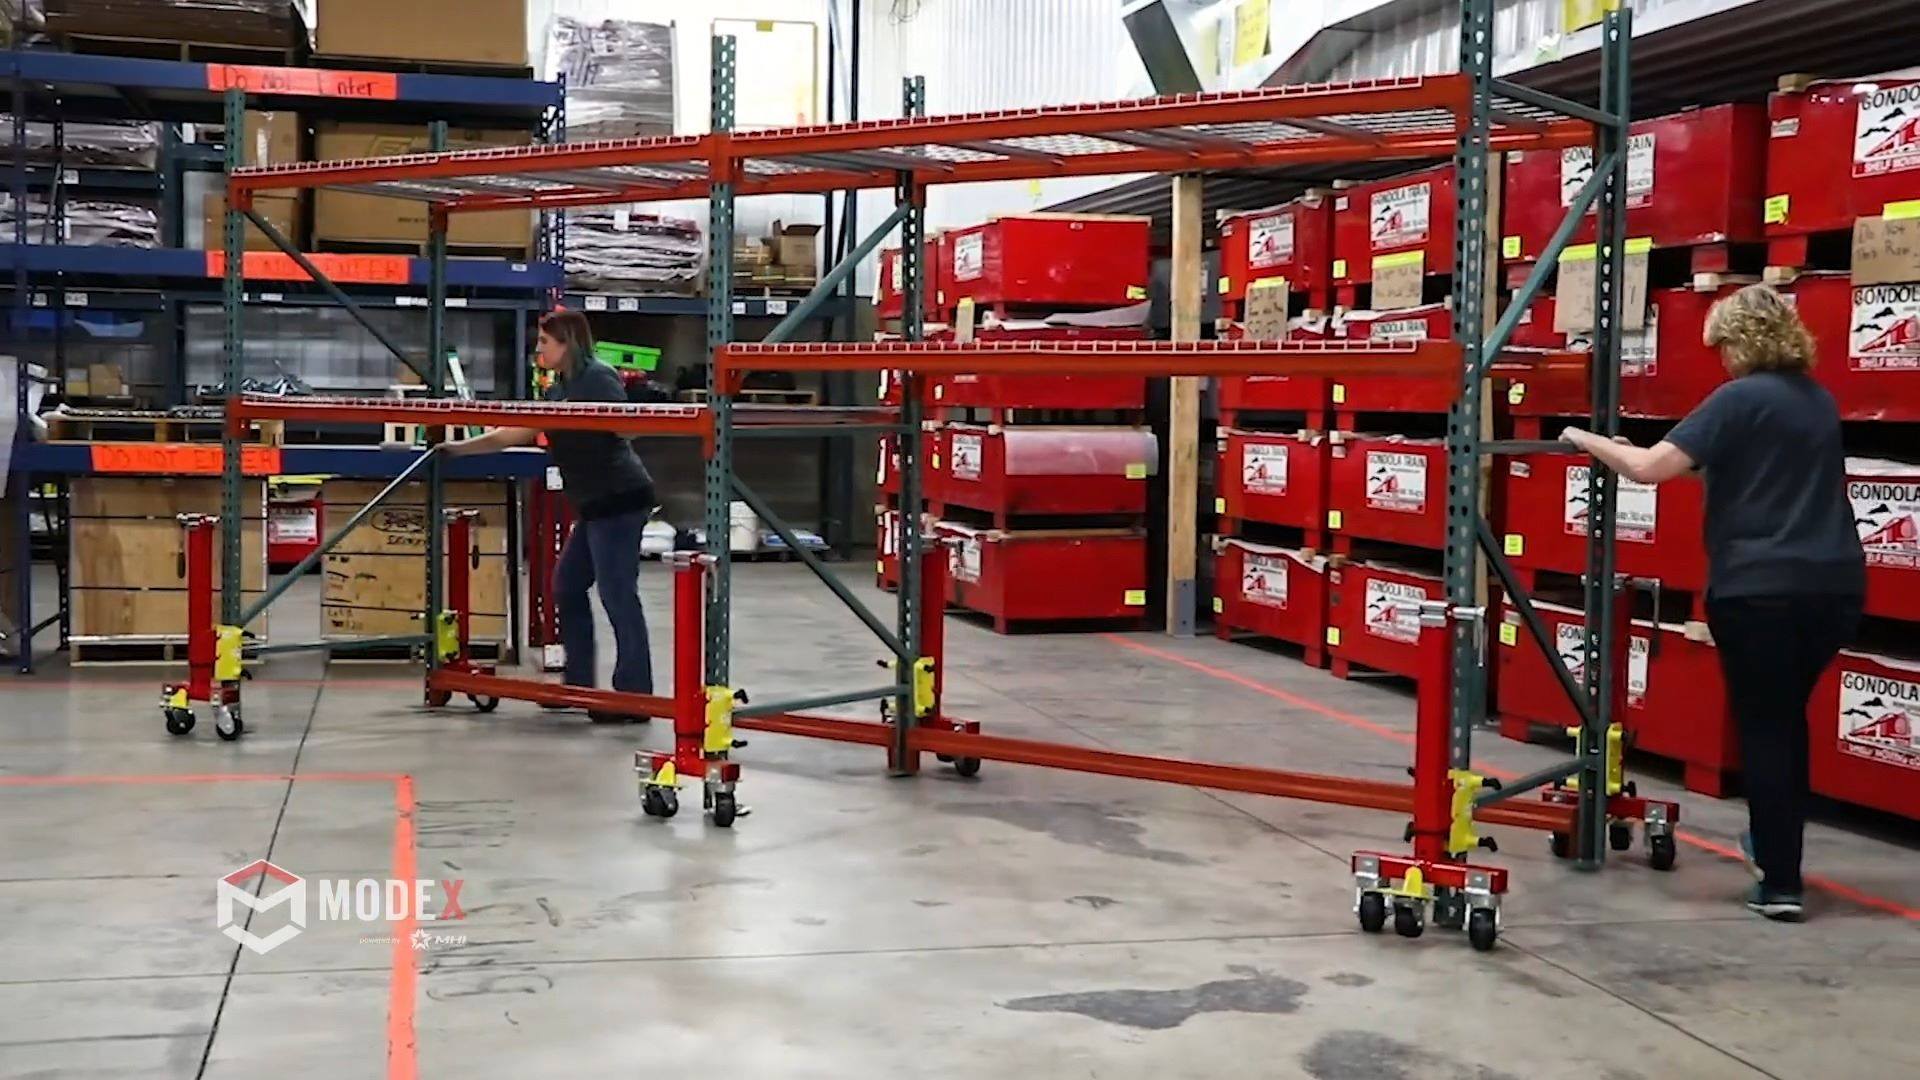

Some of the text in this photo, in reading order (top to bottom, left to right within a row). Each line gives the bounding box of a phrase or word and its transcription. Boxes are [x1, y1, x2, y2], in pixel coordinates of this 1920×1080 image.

[223, 66, 247, 90] Do
[193, 449, 272, 471] ENER
[1843, 673, 1919, 701] GONDOLA
